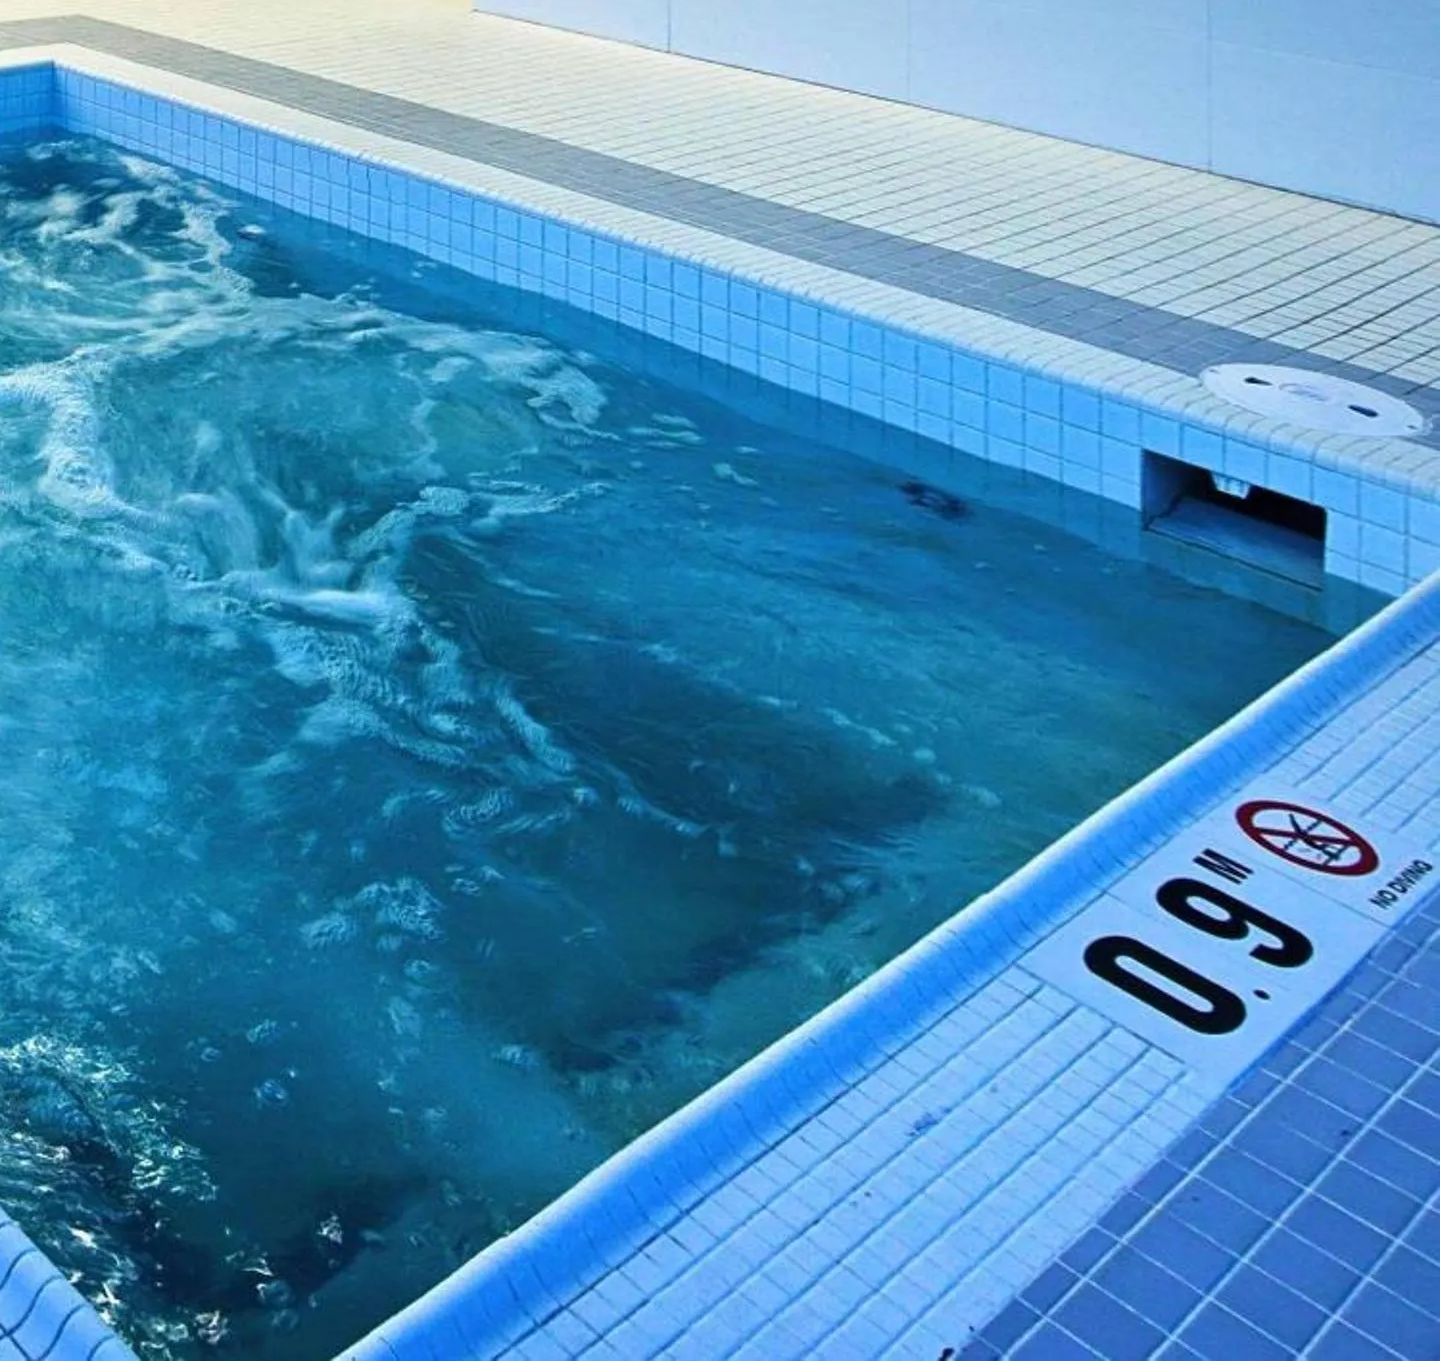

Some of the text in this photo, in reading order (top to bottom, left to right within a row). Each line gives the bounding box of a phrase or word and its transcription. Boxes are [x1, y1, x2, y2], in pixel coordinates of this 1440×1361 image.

[1368, 859, 1433, 911] NO DIVING
[1083, 878, 1314, 1035] 0.9
